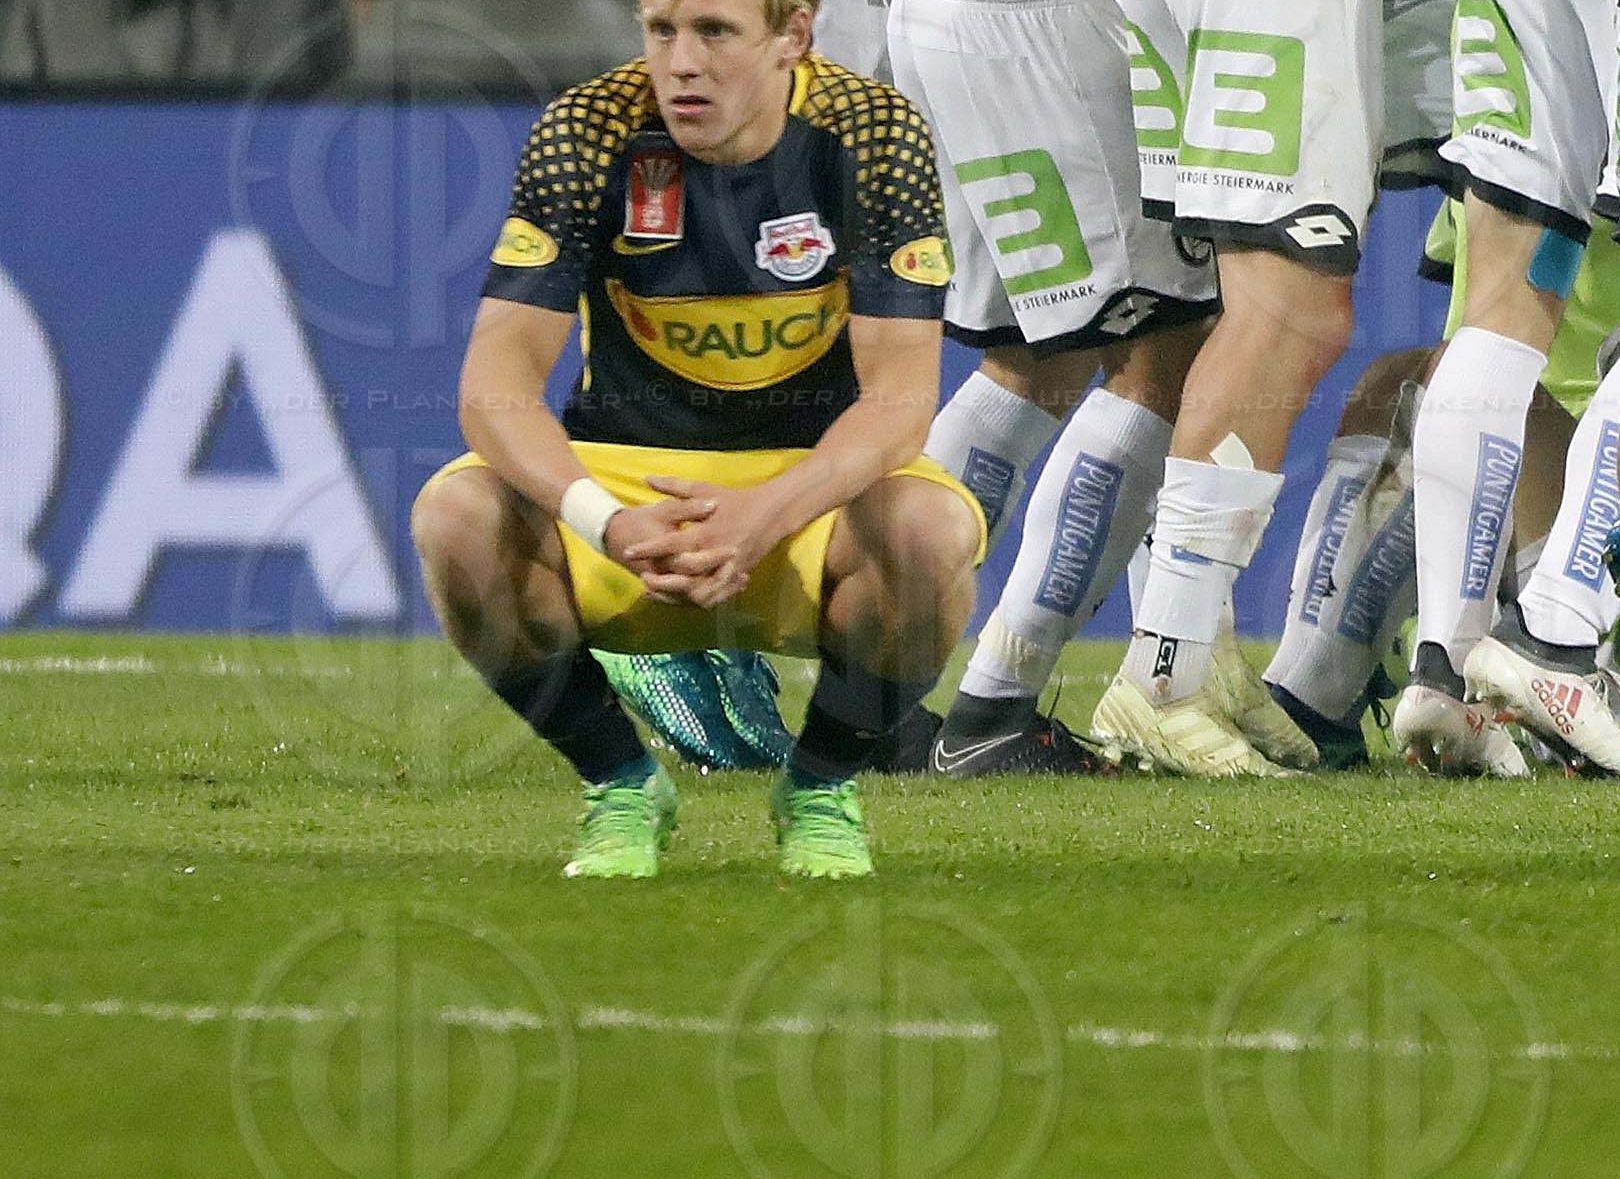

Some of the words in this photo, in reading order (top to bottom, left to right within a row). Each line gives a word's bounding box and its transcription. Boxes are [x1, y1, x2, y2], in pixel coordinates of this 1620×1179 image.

[1043, 460, 1119, 606] PUNTIGAMER
[1467, 441, 1519, 593] PUNTIGAMER
[1531, 678, 1575, 736] adidas
